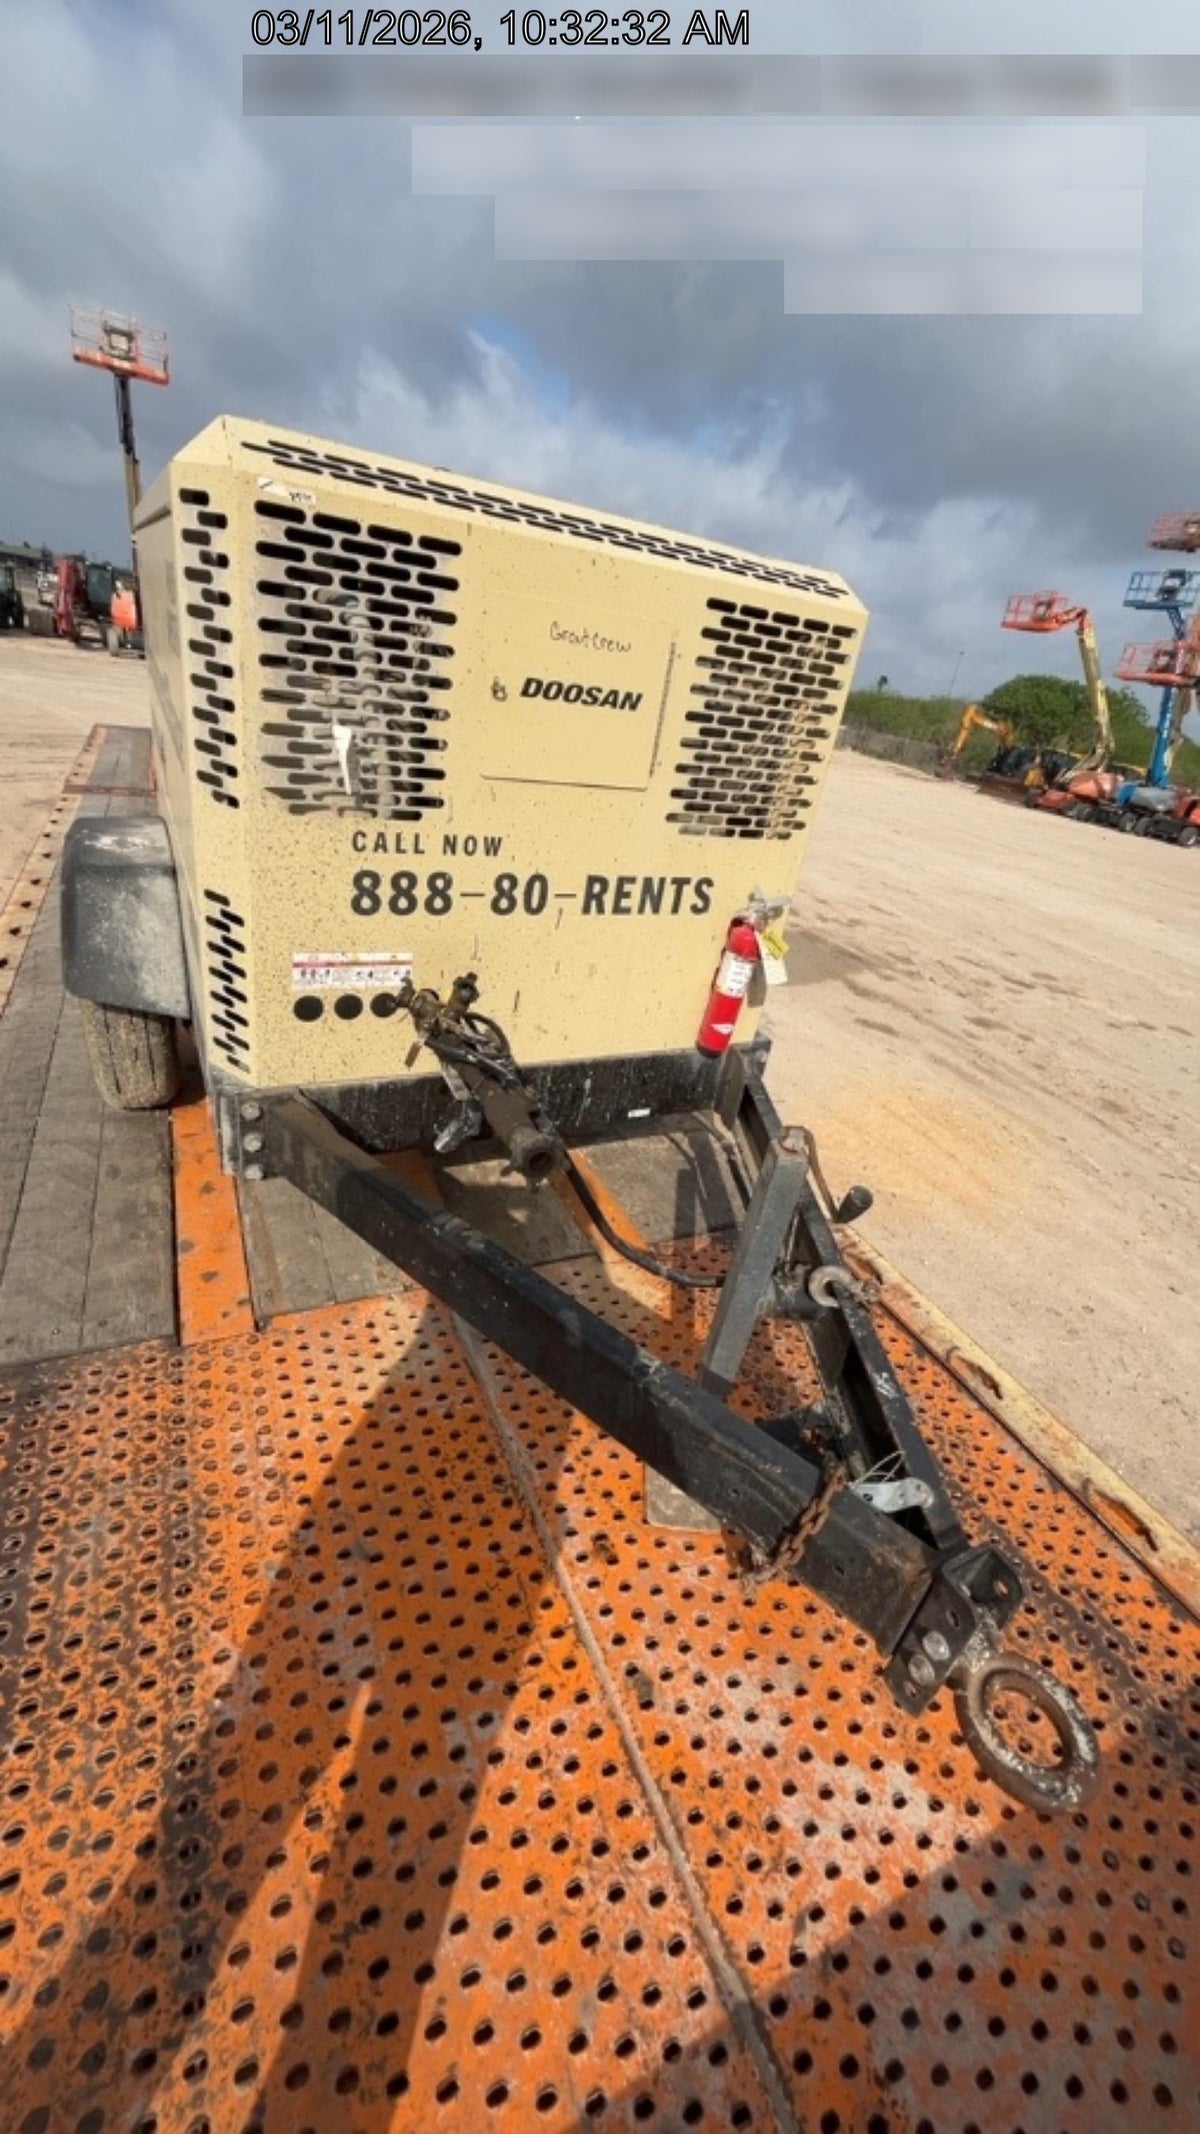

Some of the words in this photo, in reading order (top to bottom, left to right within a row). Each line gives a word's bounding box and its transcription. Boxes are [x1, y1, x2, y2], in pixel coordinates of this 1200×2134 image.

[520, 677, 643, 711] DOOSAN
[352, 831, 425, 855] CALL
[442, 834, 503, 857] NOW
[351, 869, 714, 916] 888-80-RENTS
